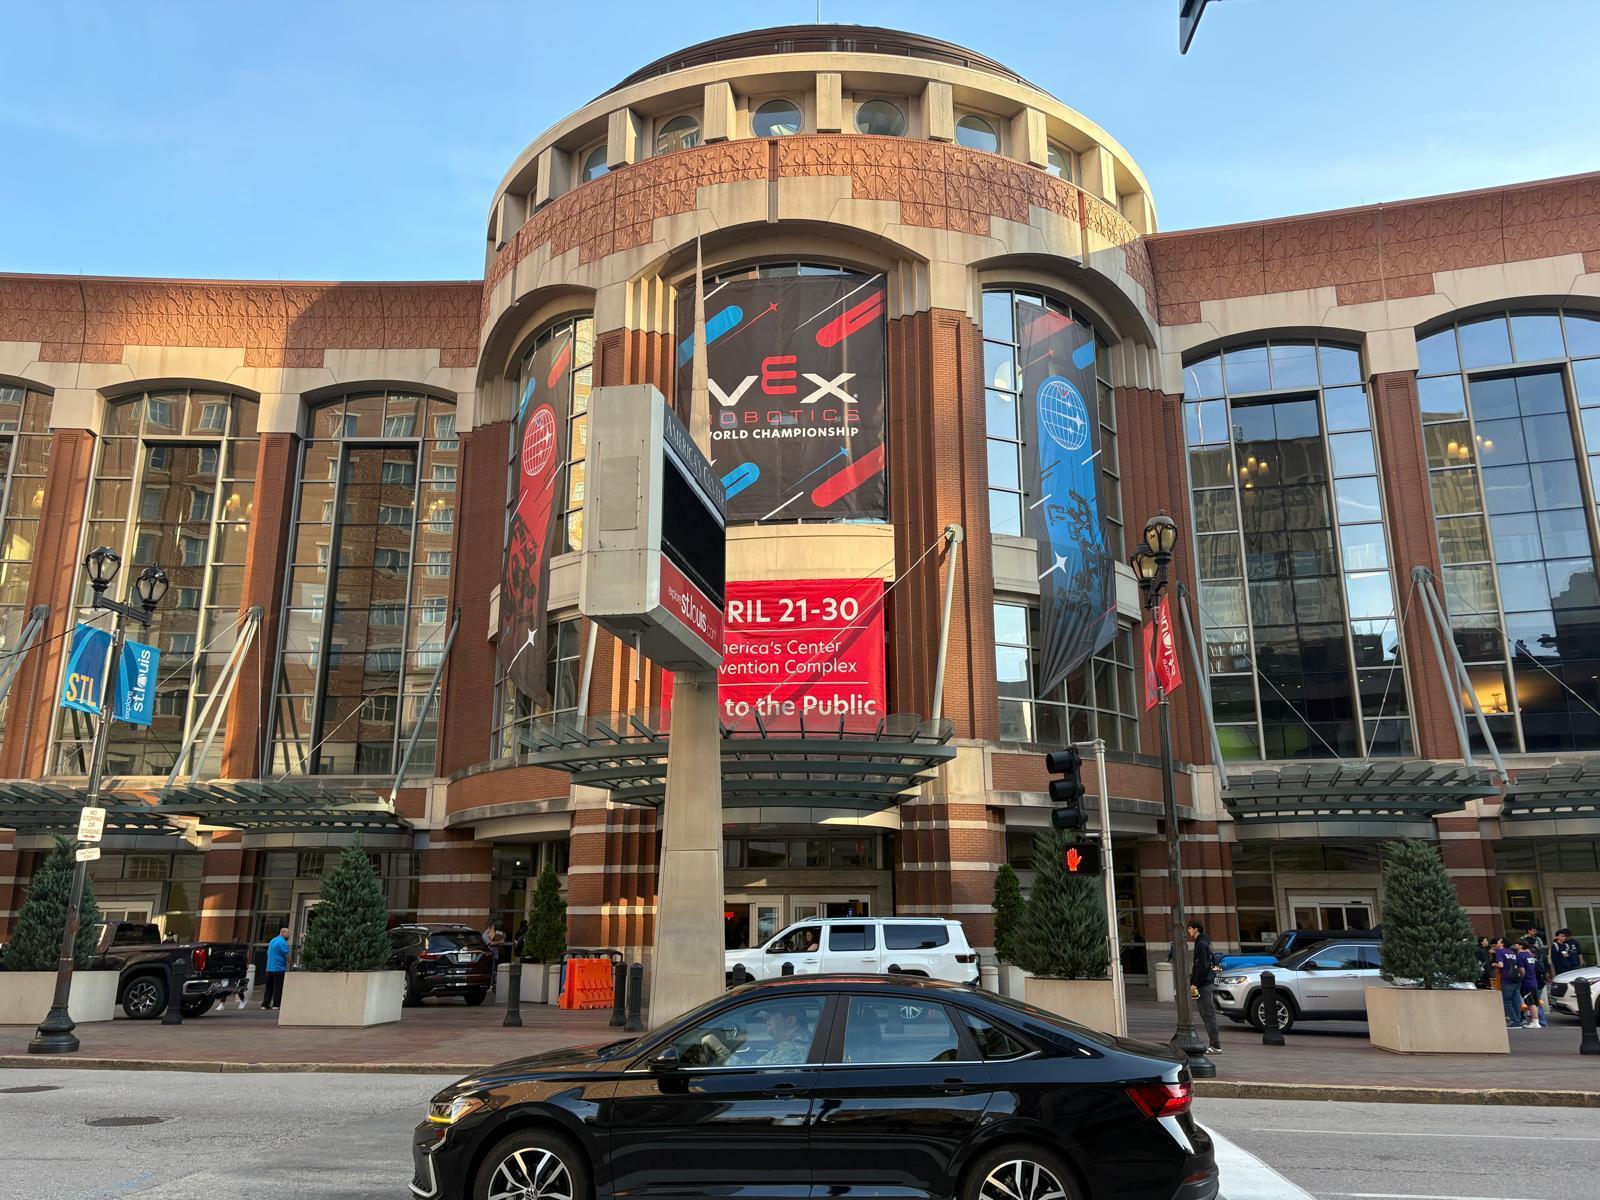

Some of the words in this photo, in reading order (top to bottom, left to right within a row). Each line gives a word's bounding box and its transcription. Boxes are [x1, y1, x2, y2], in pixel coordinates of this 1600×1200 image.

[708, 355, 858, 406] VEX
[708, 409, 861, 425] OBOTICS
[710, 430, 749, 440] ORLD
[752, 427, 859, 439] CHAMPIONSHIP
[725, 600, 771, 623] RIL
[778, 597, 858, 622] 21-30
[786, 639, 842, 653] Center
[719, 661, 779, 675] vention
[784, 657, 857, 676] Complex
[66, 673, 96, 706] STL
[725, 698, 749, 716] to
[756, 694, 795, 715] the
[803, 693, 876, 715] Public
